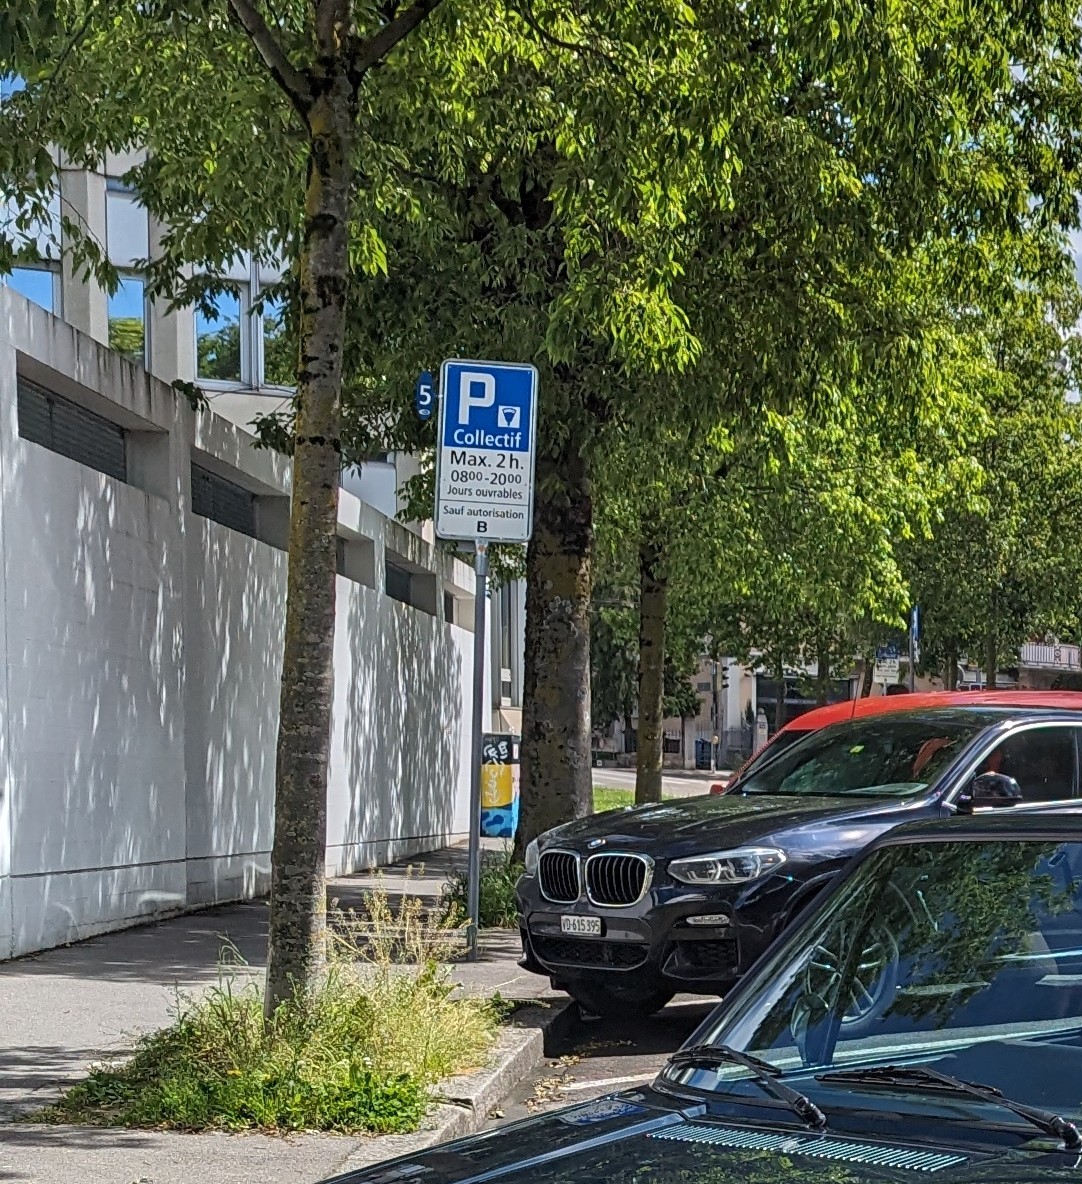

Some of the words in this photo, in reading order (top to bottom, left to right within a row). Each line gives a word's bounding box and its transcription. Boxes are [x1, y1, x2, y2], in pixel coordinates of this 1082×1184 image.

[419, 385, 432, 405] 5
[458, 372, 496, 425] P
[454, 429, 522, 449] Collectif
[450, 451, 491, 468] Max.
[447, 484, 473, 497] Jours
[475, 488, 523, 500] ouvrables
[443, 505, 465, 516] Sauf
[466, 507, 524, 519] autorisation
[476, 521, 488, 533] B
